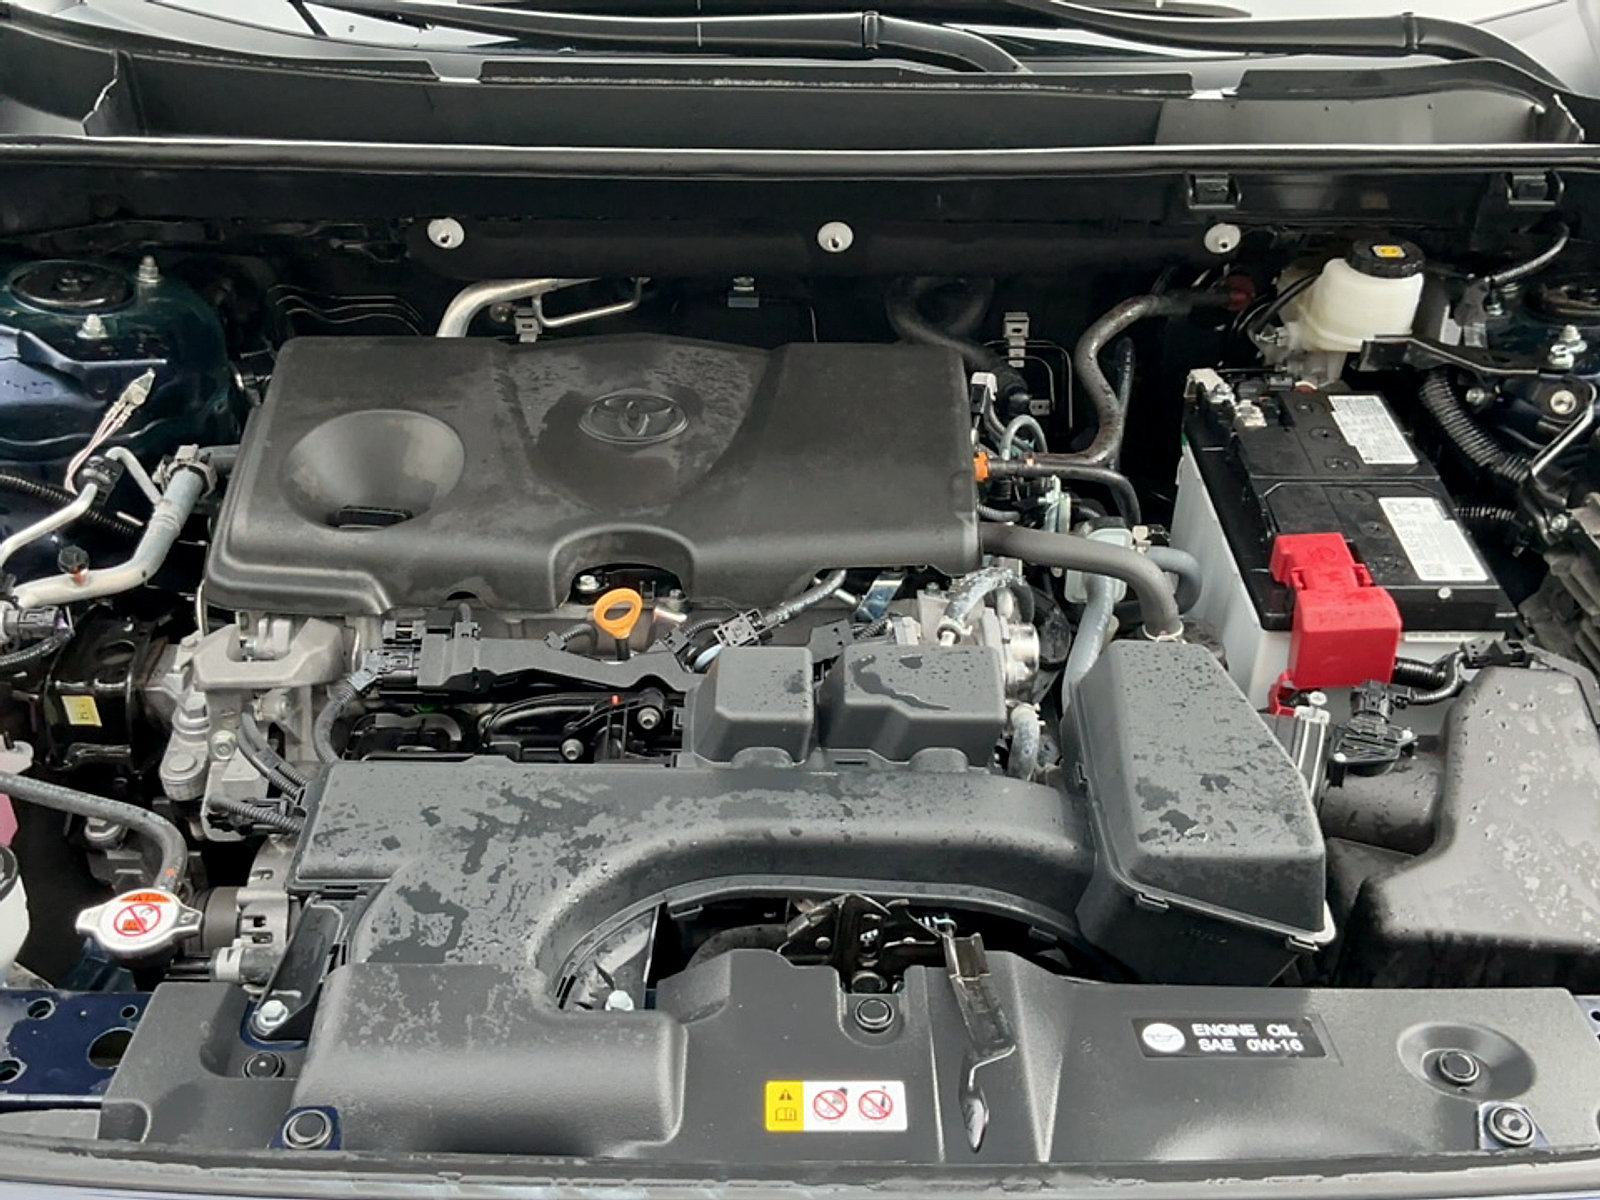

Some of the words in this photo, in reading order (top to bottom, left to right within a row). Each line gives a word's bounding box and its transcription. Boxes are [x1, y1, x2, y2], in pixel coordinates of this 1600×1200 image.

[1191, 1023, 1258, 1037] ENGINE
[1266, 1023, 1298, 1037] OIL
[1198, 1038, 1237, 1052] SAE
[1246, 1038, 1305, 1052] 0W-16
